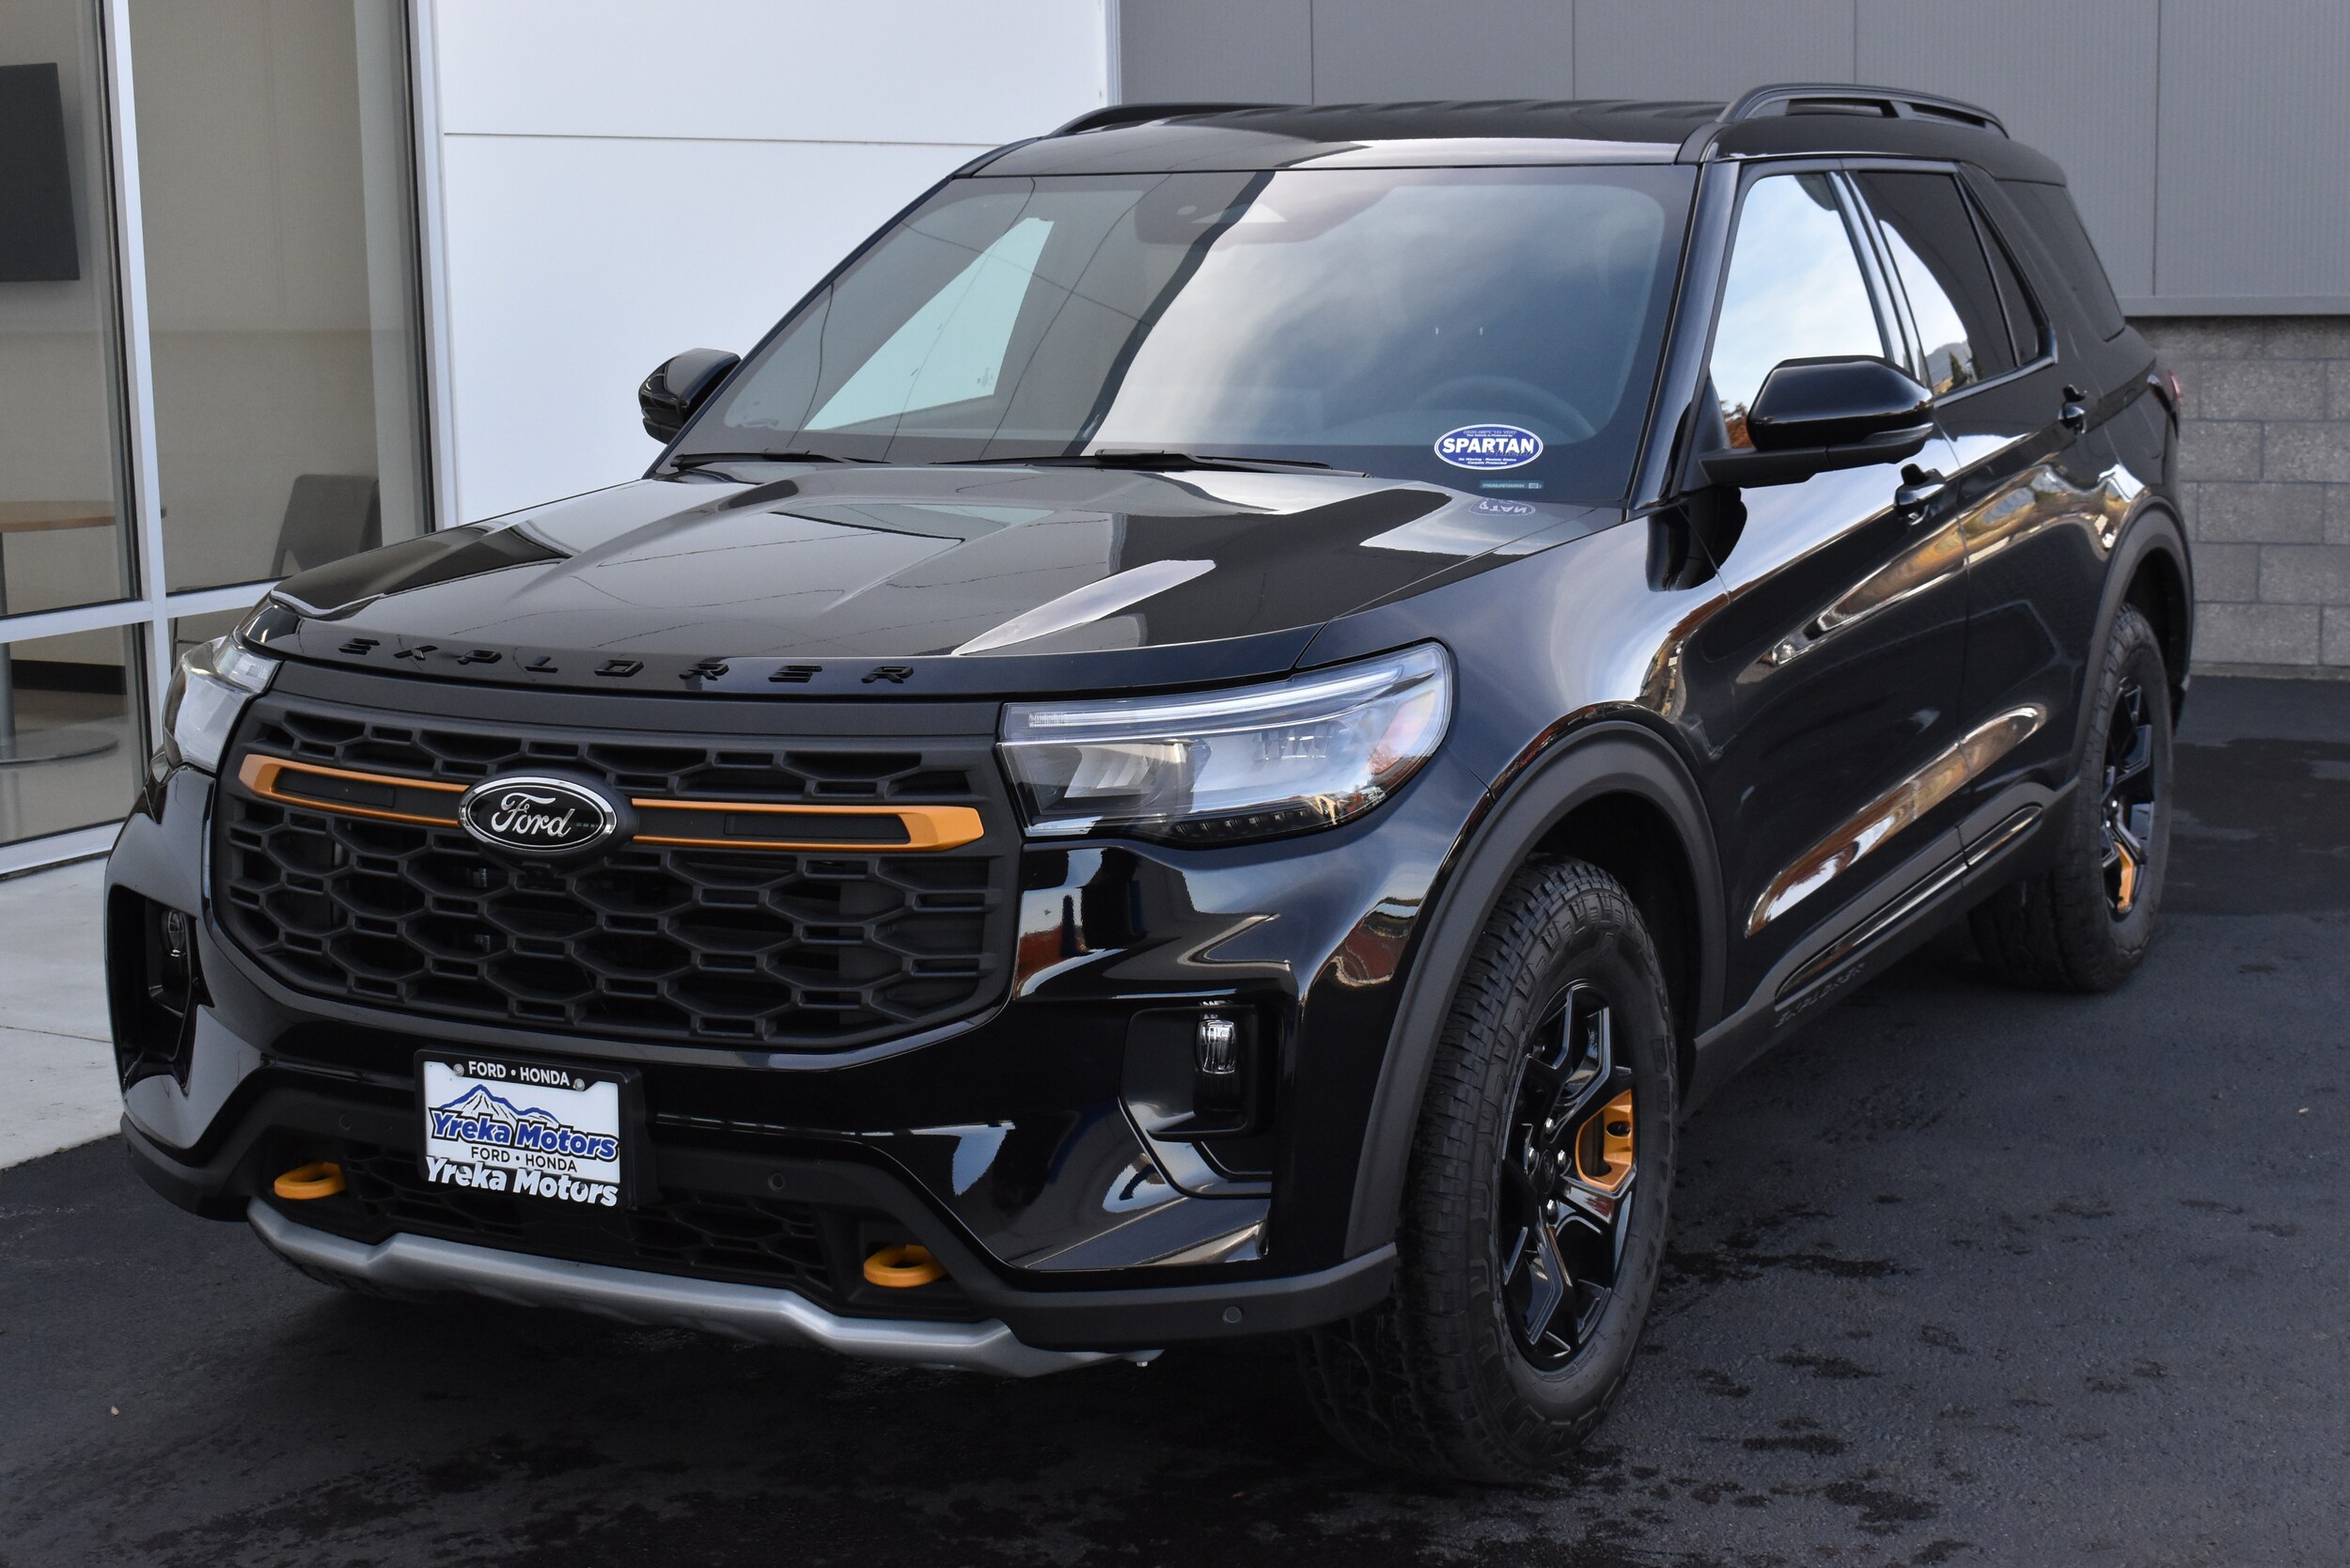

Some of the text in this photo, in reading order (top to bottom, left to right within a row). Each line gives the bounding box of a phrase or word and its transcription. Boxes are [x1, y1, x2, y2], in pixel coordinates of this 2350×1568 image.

[1442, 437, 1535, 454] SPARTAN
[337, 637, 914, 684] EXPLORER
[491, 792, 576, 838] Ford
[468, 1060, 571, 1087] FORD HONDA
[430, 1108, 619, 1161] Yreka Motors
[425, 1155, 619, 1207] Yreka Motors
[471, 1147, 578, 1173] FORD HONDA
